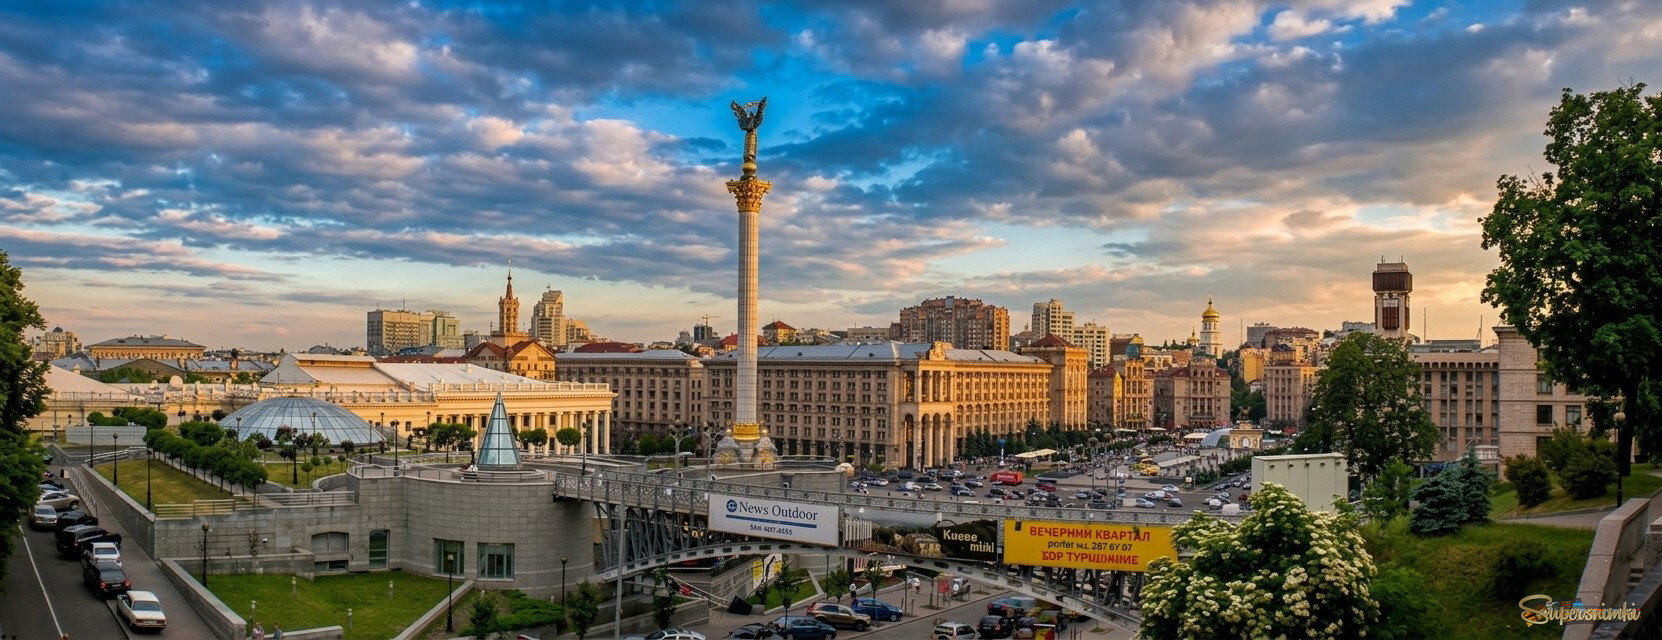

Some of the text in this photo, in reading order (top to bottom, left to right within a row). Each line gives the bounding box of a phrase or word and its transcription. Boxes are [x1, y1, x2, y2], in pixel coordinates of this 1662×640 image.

[739, 501, 818, 521] News Outdoor
[1095, 529, 1150, 542] КВАРТАЛ
